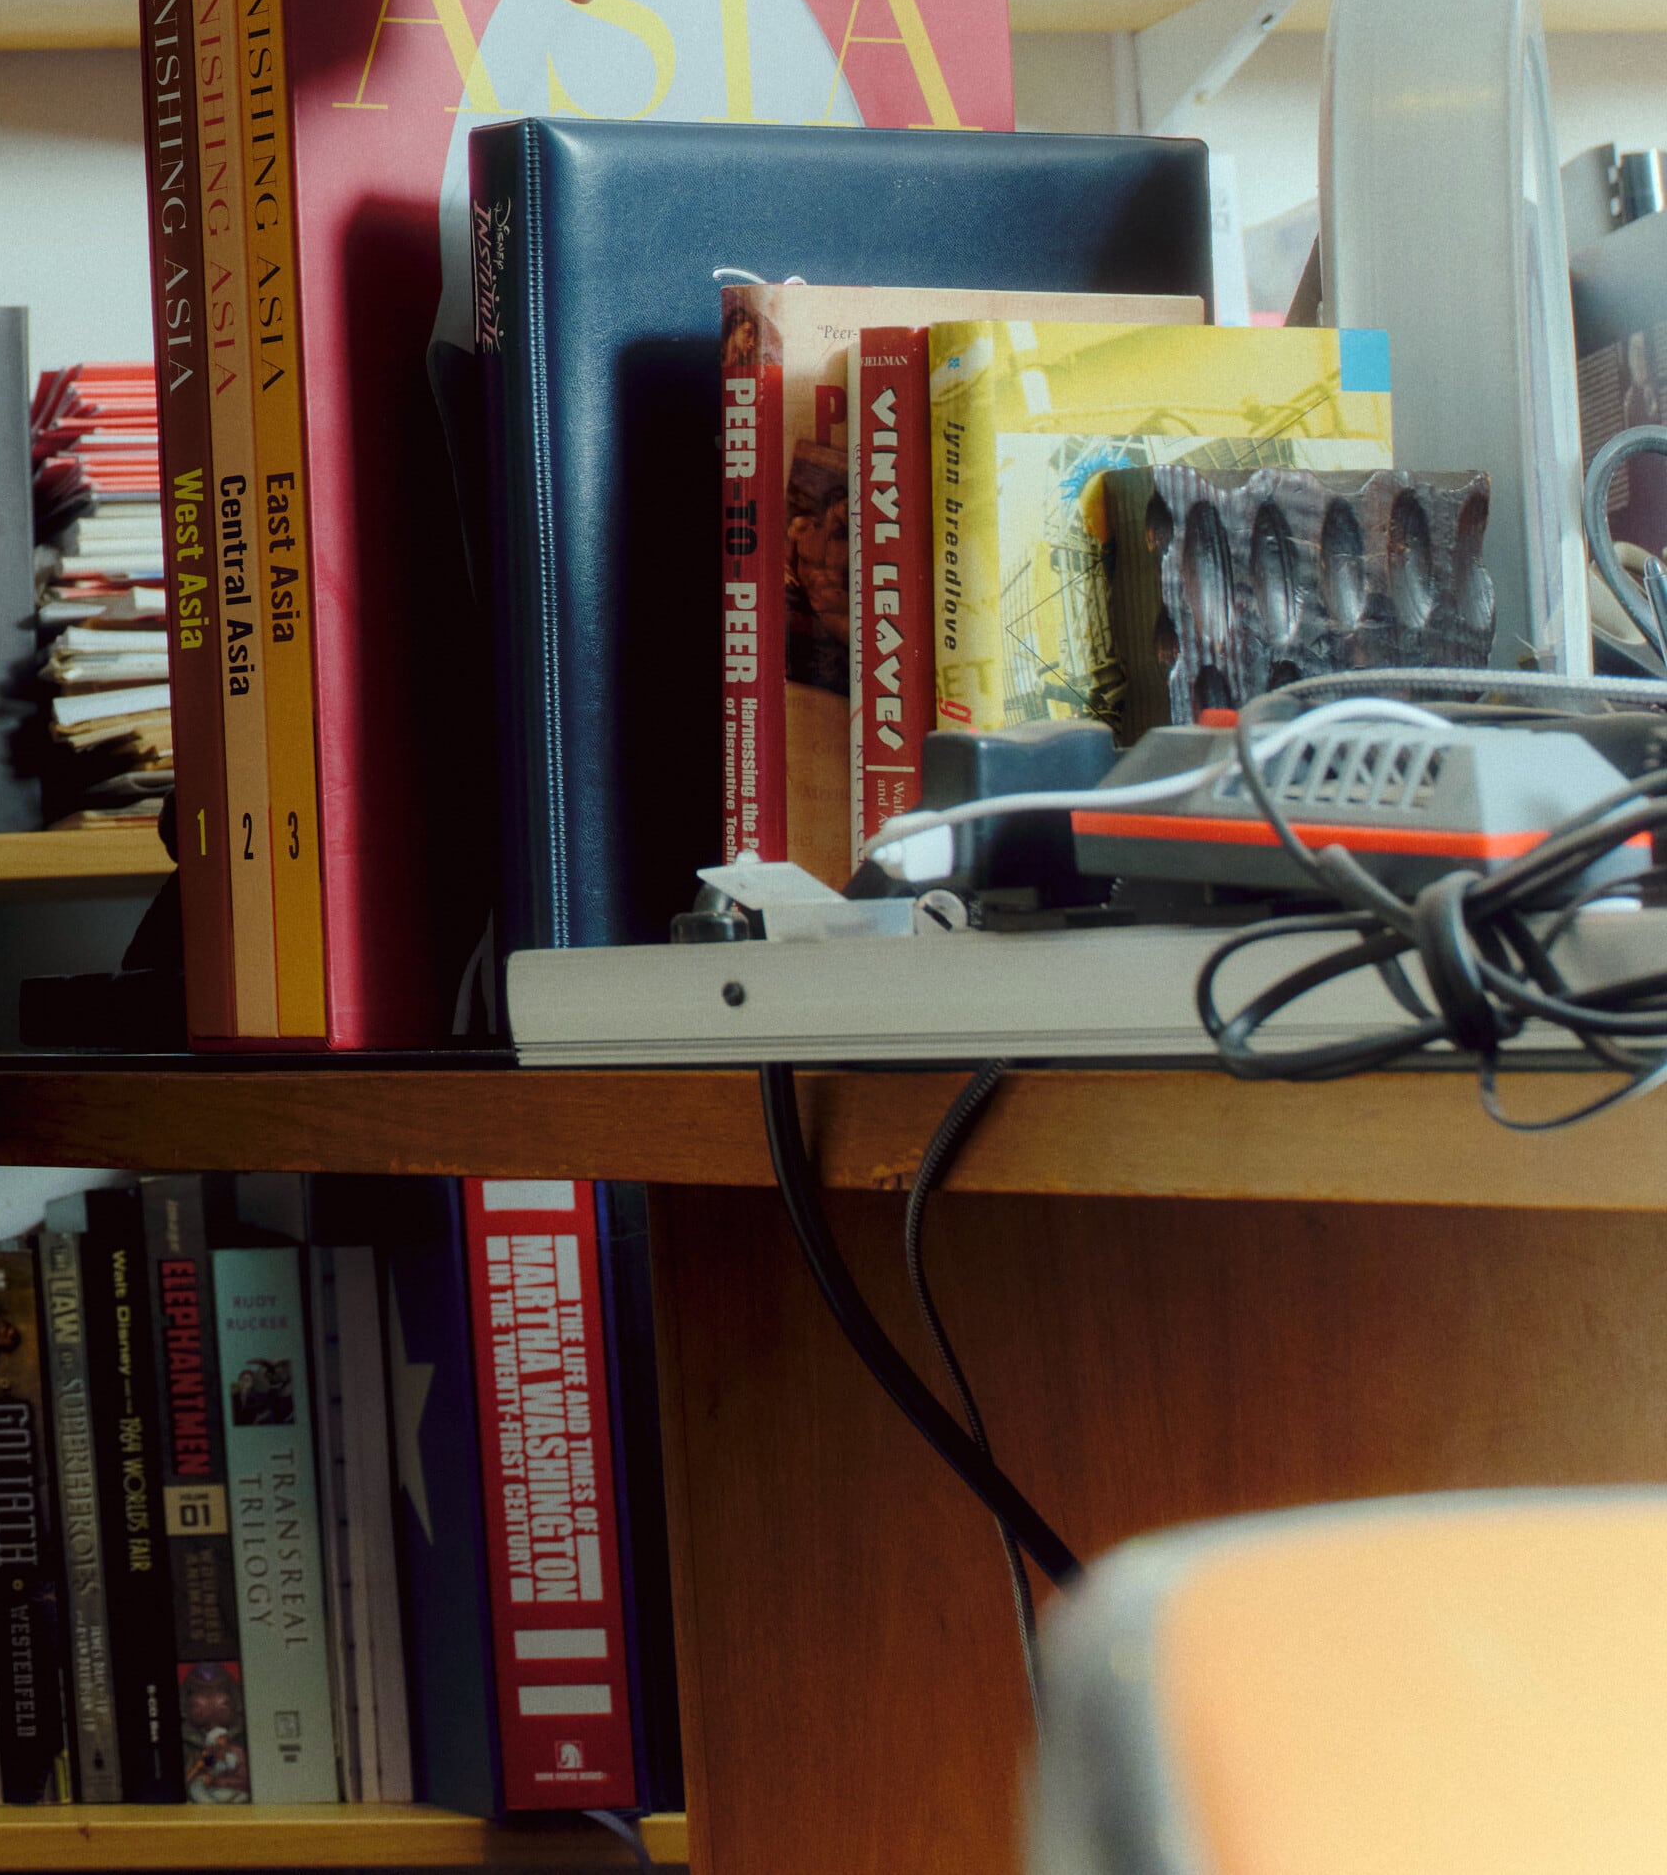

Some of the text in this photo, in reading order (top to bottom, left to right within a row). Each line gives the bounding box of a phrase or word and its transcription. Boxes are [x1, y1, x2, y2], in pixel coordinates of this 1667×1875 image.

[164, 255, 197, 395] ASIA
[209, 258, 240, 398] ASIA
[255, 258, 286, 393] ASIA
[171, 466, 207, 560] West
[218, 471, 253, 612] Central
[263, 471, 299, 555] East
[869, 387, 906, 752] VINYL LEAVES
[942, 420, 966, 651] lynn breedlove
[177, 569, 210, 651] Asia
[224, 619, 257, 698] Asia
[268, 565, 302, 644] Asia
[724, 697, 739, 811] of Disruptive
[739, 696, 760, 798] Harnessing
[876, 779, 890, 807] and
[892, 780, 906, 814] Walt
[197, 808, 207, 857] 1
[241, 812, 256, 863] 2
[284, 811, 302, 862] 3
[741, 803, 760, 833] the
[109, 1249, 153, 1573] Walt Disney 1964 FAIR
[160, 1259, 210, 1476] ELEPHANTMEN
[487, 1262, 531, 1575] IN THE TWENTY-FIRST CENTURY
[511, 1234, 579, 1603] MARTHA WASHINGTON
[559, 1303, 598, 1533] THE LIFE AND TIMES OF
[48, 1277, 102, 1597] LAW SUPERHEROES
[237, 1471, 273, 1626] TRILOGY
[269, 1447, 310, 1649] TRANSREAL
[6, 1604, 38, 1739] WESTERFELD
